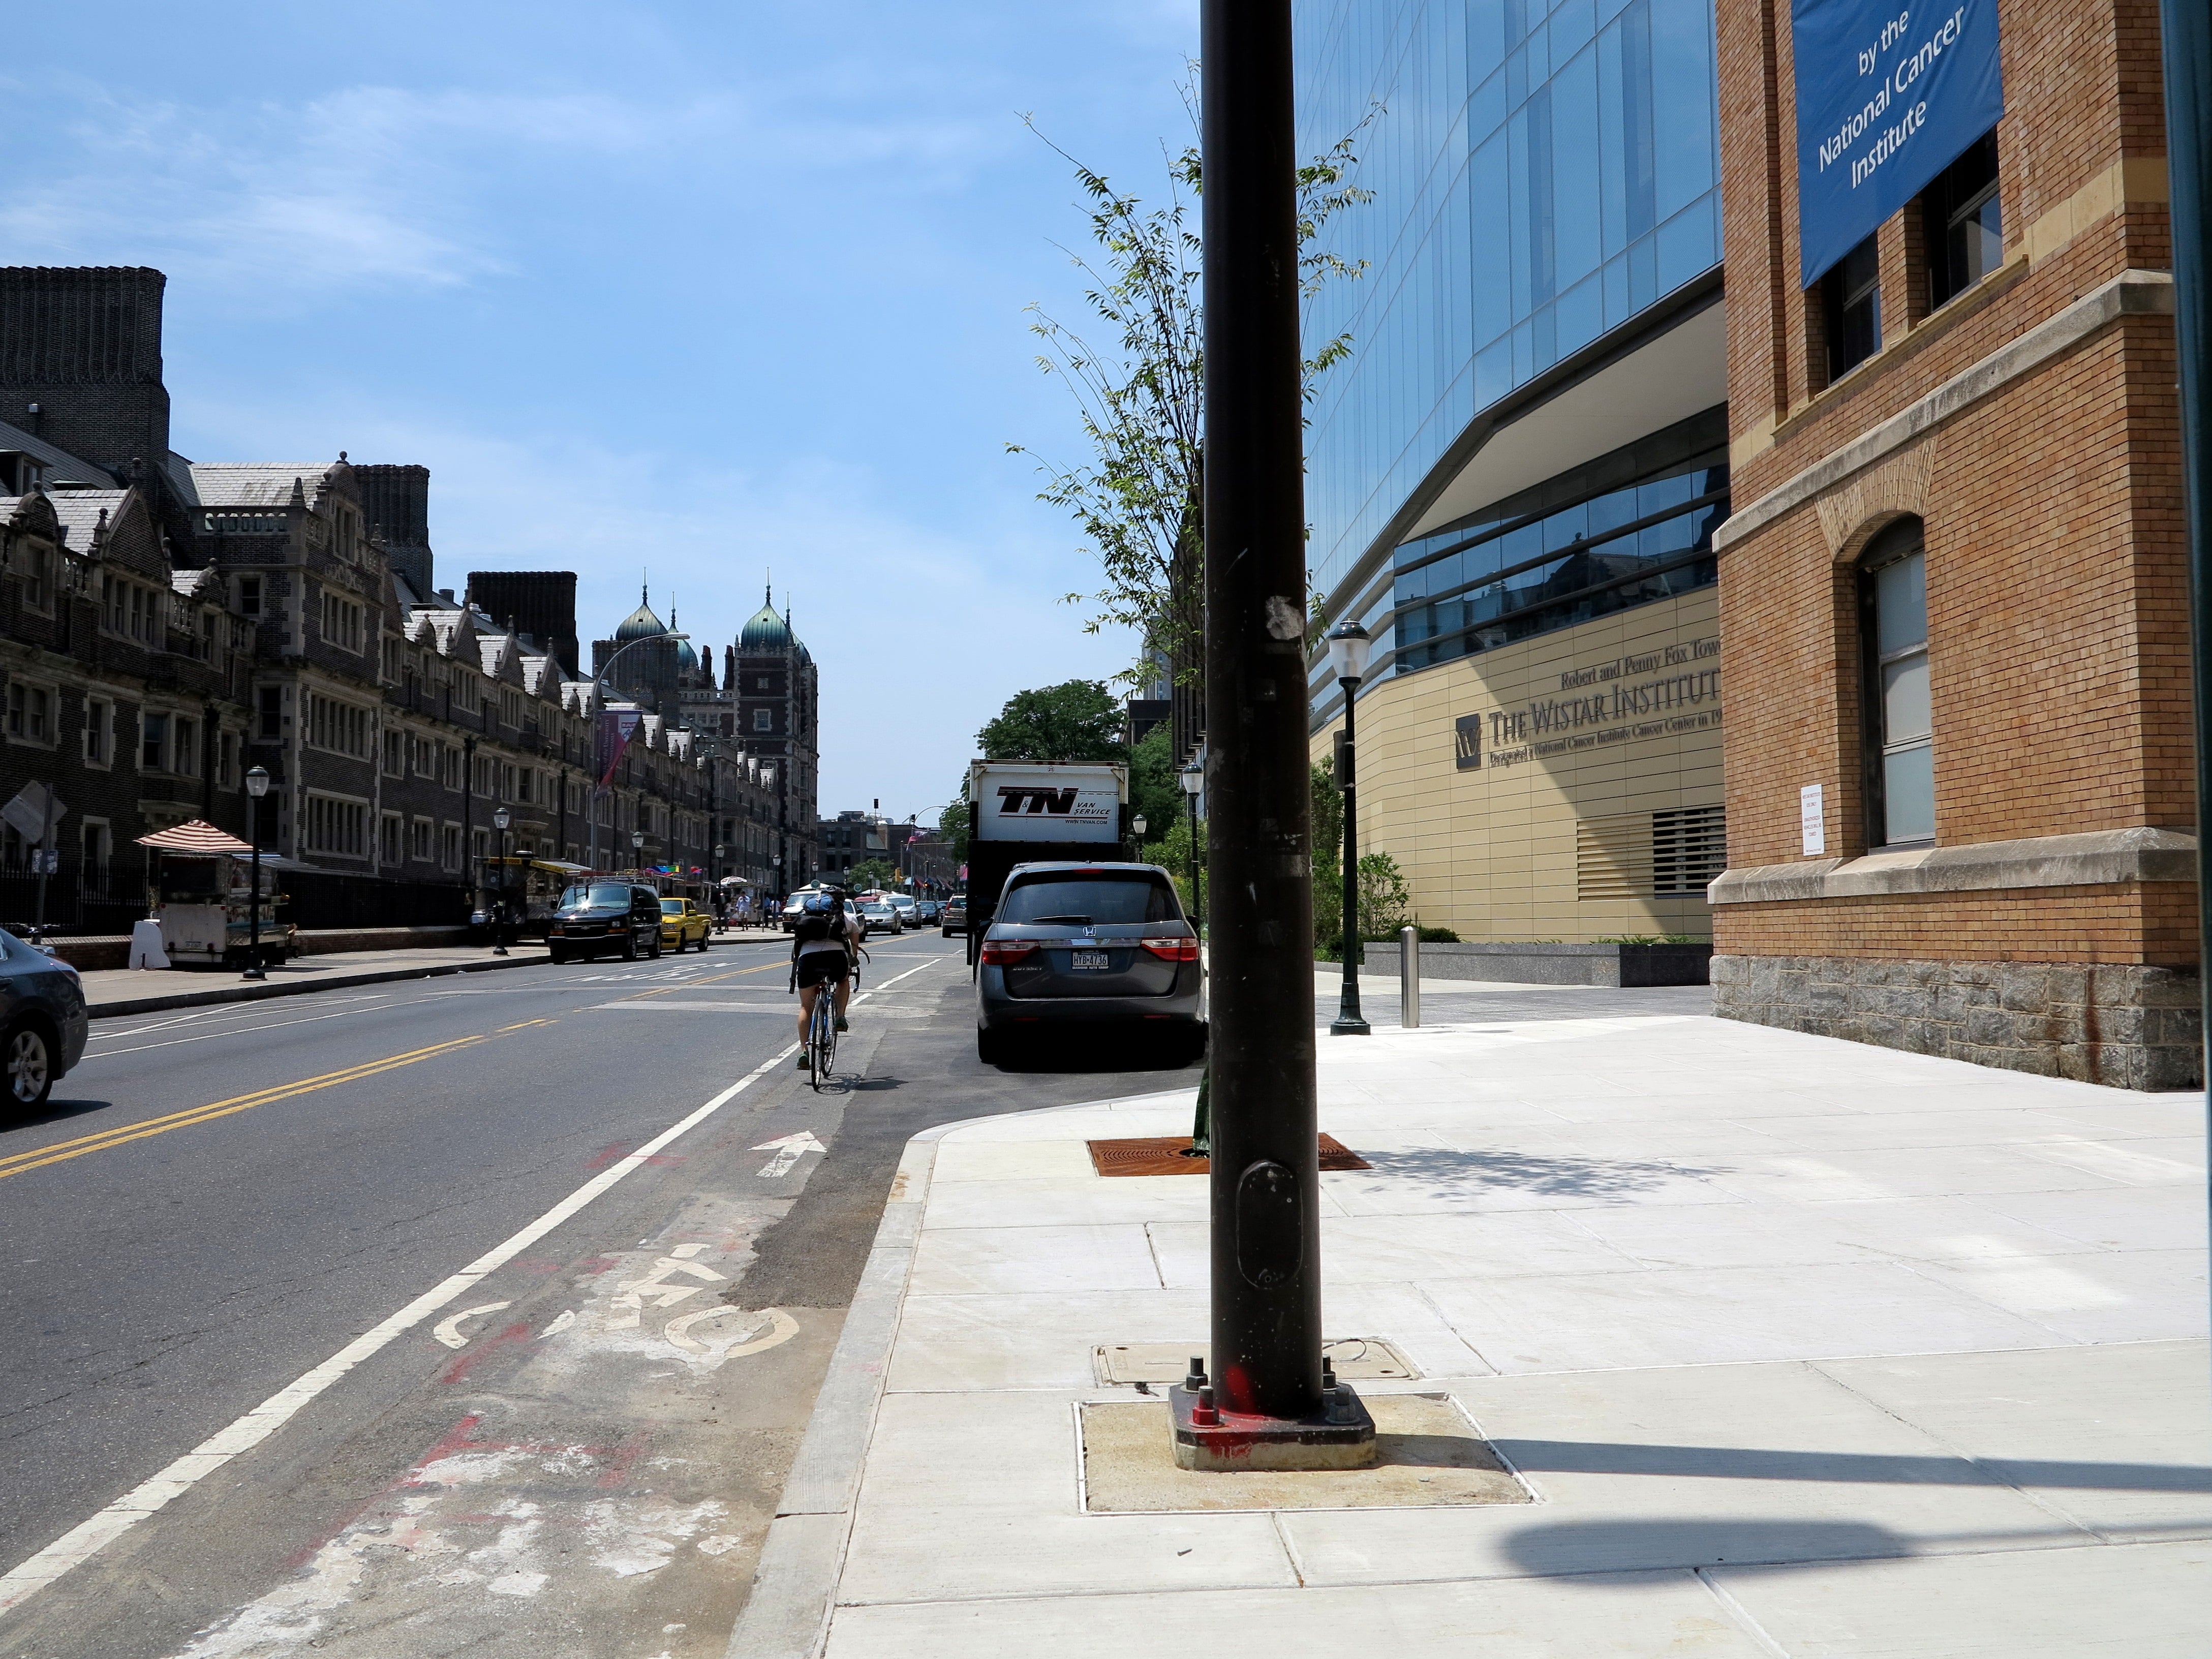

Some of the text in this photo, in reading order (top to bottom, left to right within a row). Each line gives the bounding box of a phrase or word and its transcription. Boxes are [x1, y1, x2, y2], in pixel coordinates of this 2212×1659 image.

[1858, 10, 1909, 76] by the
[1819, 6, 1965, 173] National Cancer
[1851, 101, 1926, 189] Institute
[1560, 639, 1721, 690] Robert and Penny Fox Tow
[1489, 711, 1526, 744] THE
[1529, 693, 1608, 735] WISTAR
[1534, 738, 1566, 755] National
[1568, 735, 1595, 749] Cancer
[1597, 727, 1630, 744] Institute
[1632, 722, 1663, 737] Cancer
[1665, 717, 1696, 732] Center
[1698, 713, 1708, 726] in
